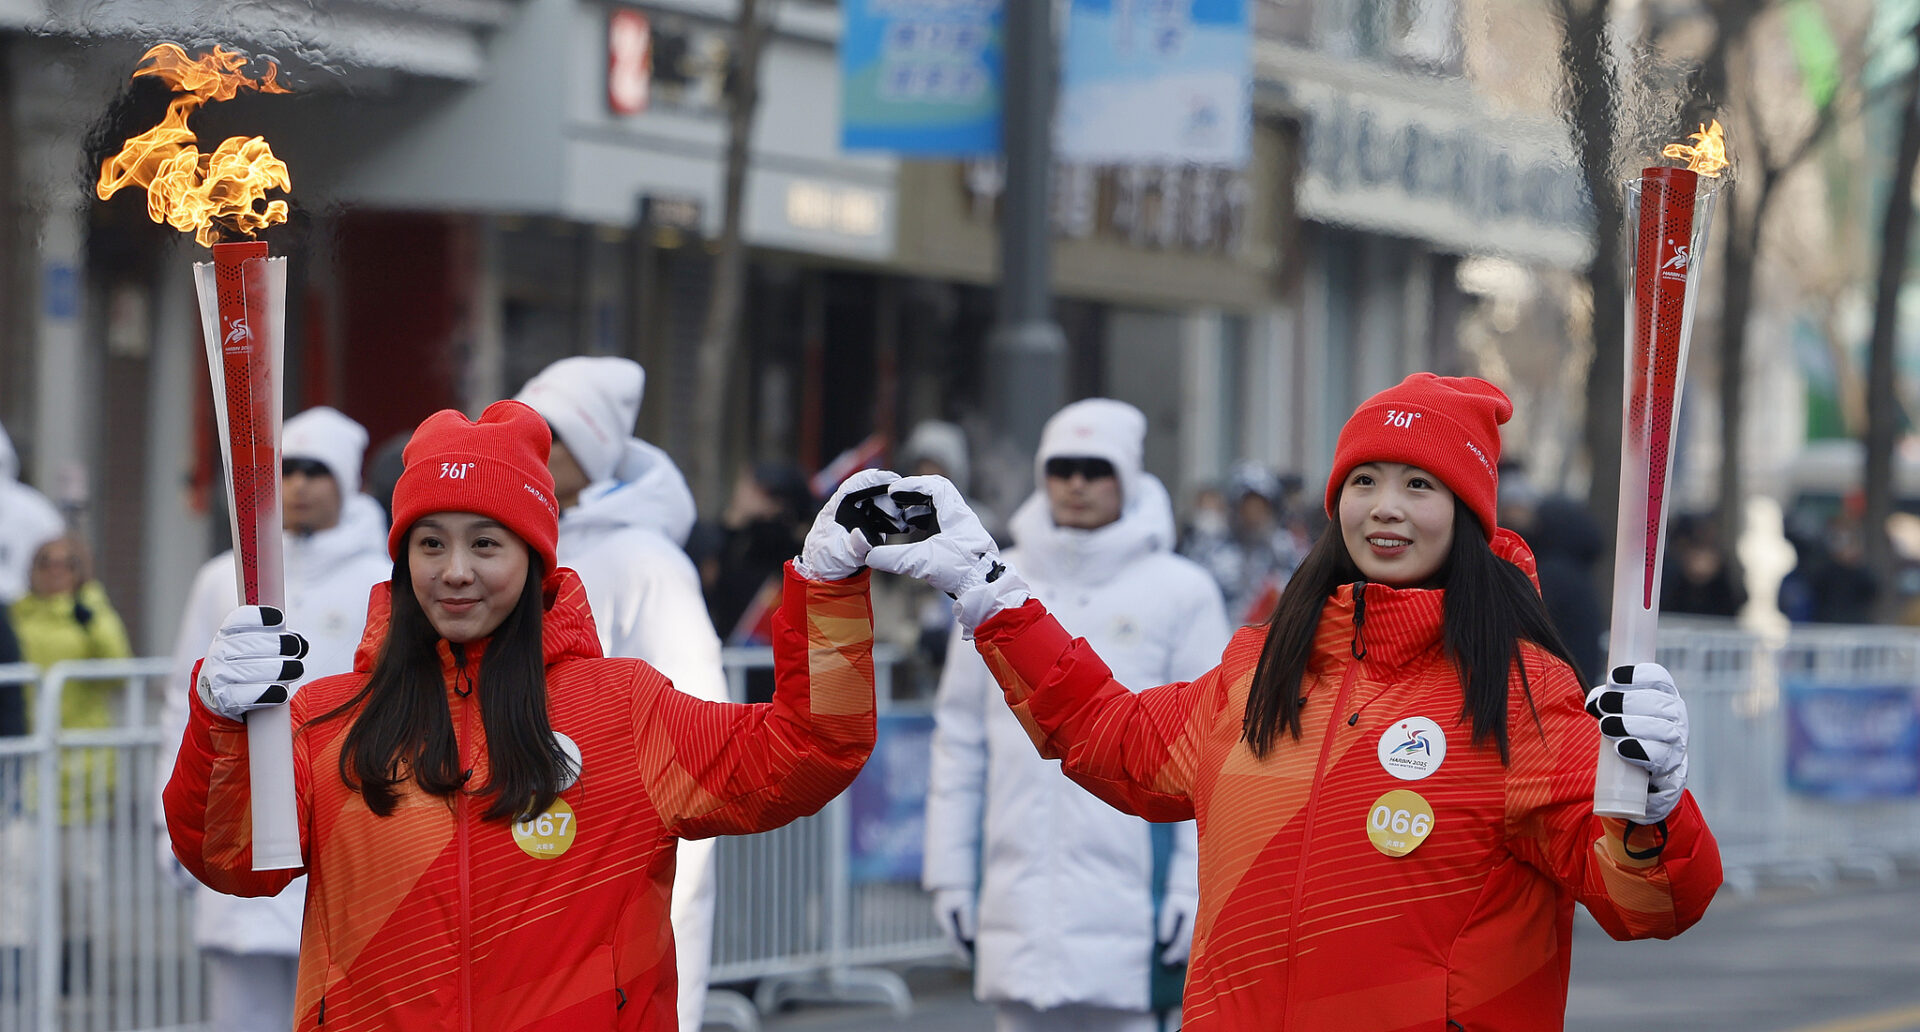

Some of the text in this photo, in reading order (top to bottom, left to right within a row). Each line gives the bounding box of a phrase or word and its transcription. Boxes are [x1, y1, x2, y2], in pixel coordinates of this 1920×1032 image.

[1384, 410, 1422, 429] 361°
[439, 462, 476, 479] 361°
[1389, 756, 1428, 768] HARBIN 2025
[516, 812, 572, 837] 067
[1372, 805, 1431, 837] 066
